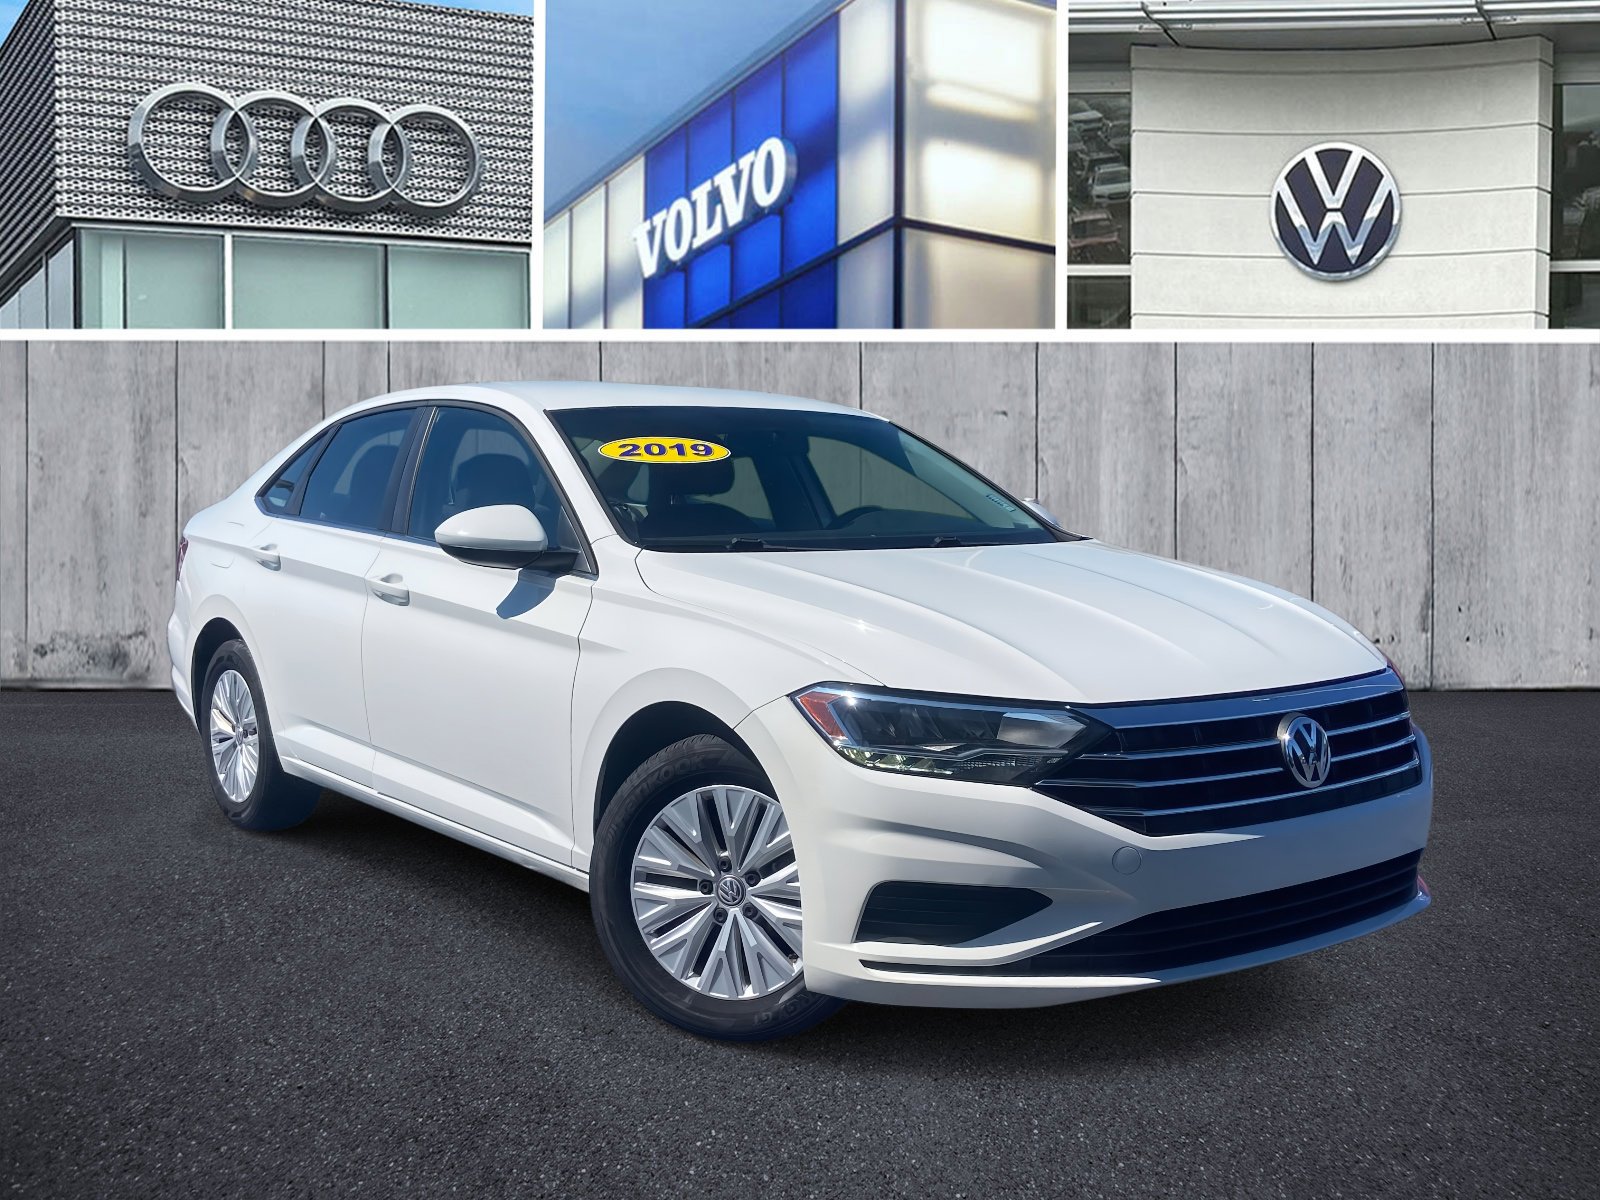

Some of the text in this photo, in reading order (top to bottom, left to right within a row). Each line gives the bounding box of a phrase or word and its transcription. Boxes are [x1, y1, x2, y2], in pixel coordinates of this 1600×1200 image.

[632, 136, 790, 279] VOLVO
[1270, 141, 1402, 281] VW
[618, 443, 713, 457] 2019
[1284, 716, 1331, 788] VW
